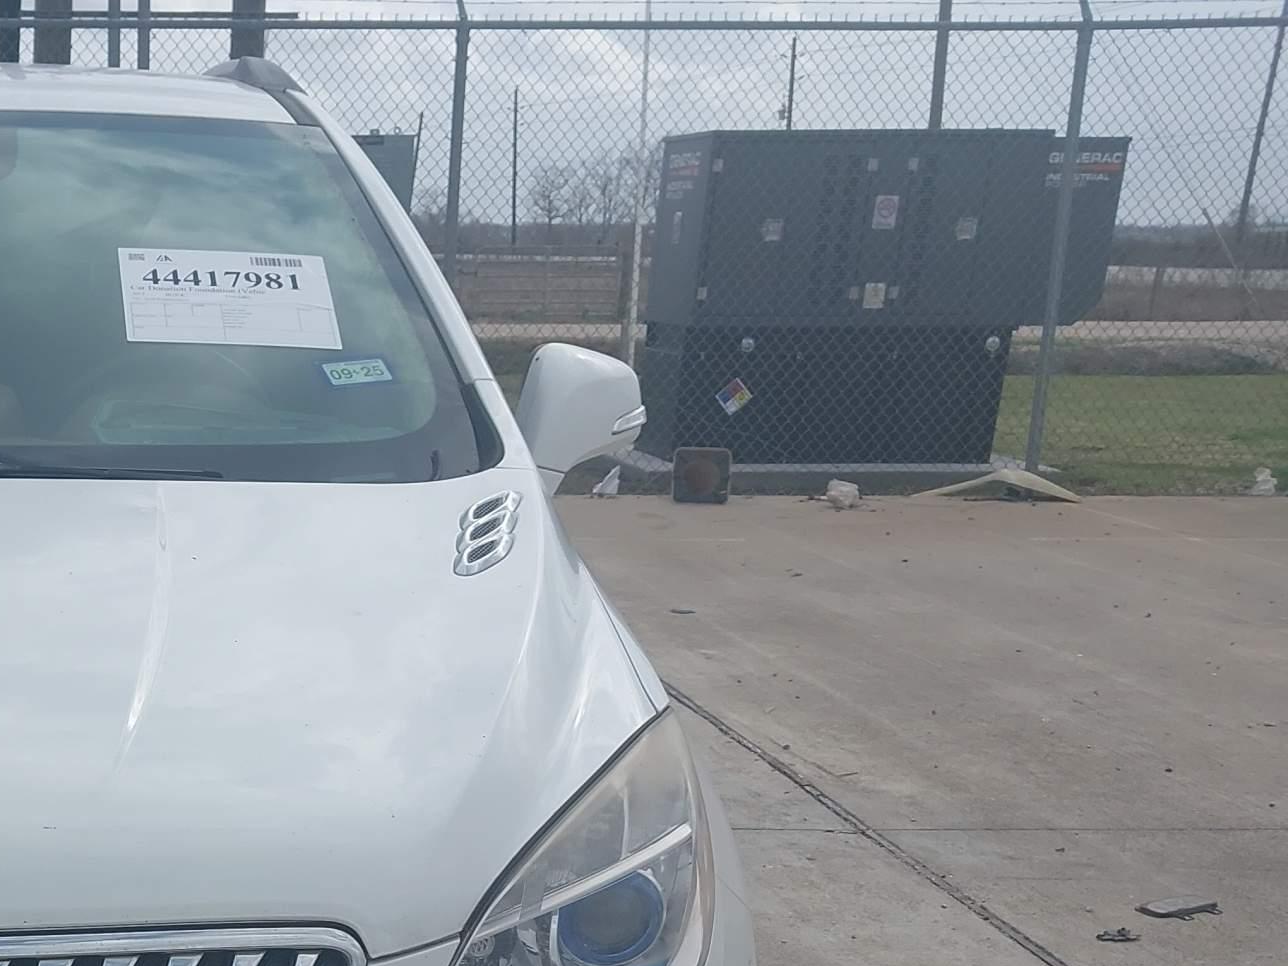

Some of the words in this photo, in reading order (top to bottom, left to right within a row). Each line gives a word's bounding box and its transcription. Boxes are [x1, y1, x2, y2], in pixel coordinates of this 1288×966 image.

[1048, 152, 1123, 164] GERAC
[142, 268, 301, 290] 44417981
[329, 368, 353, 380] 09
[360, 365, 385, 377] 25
